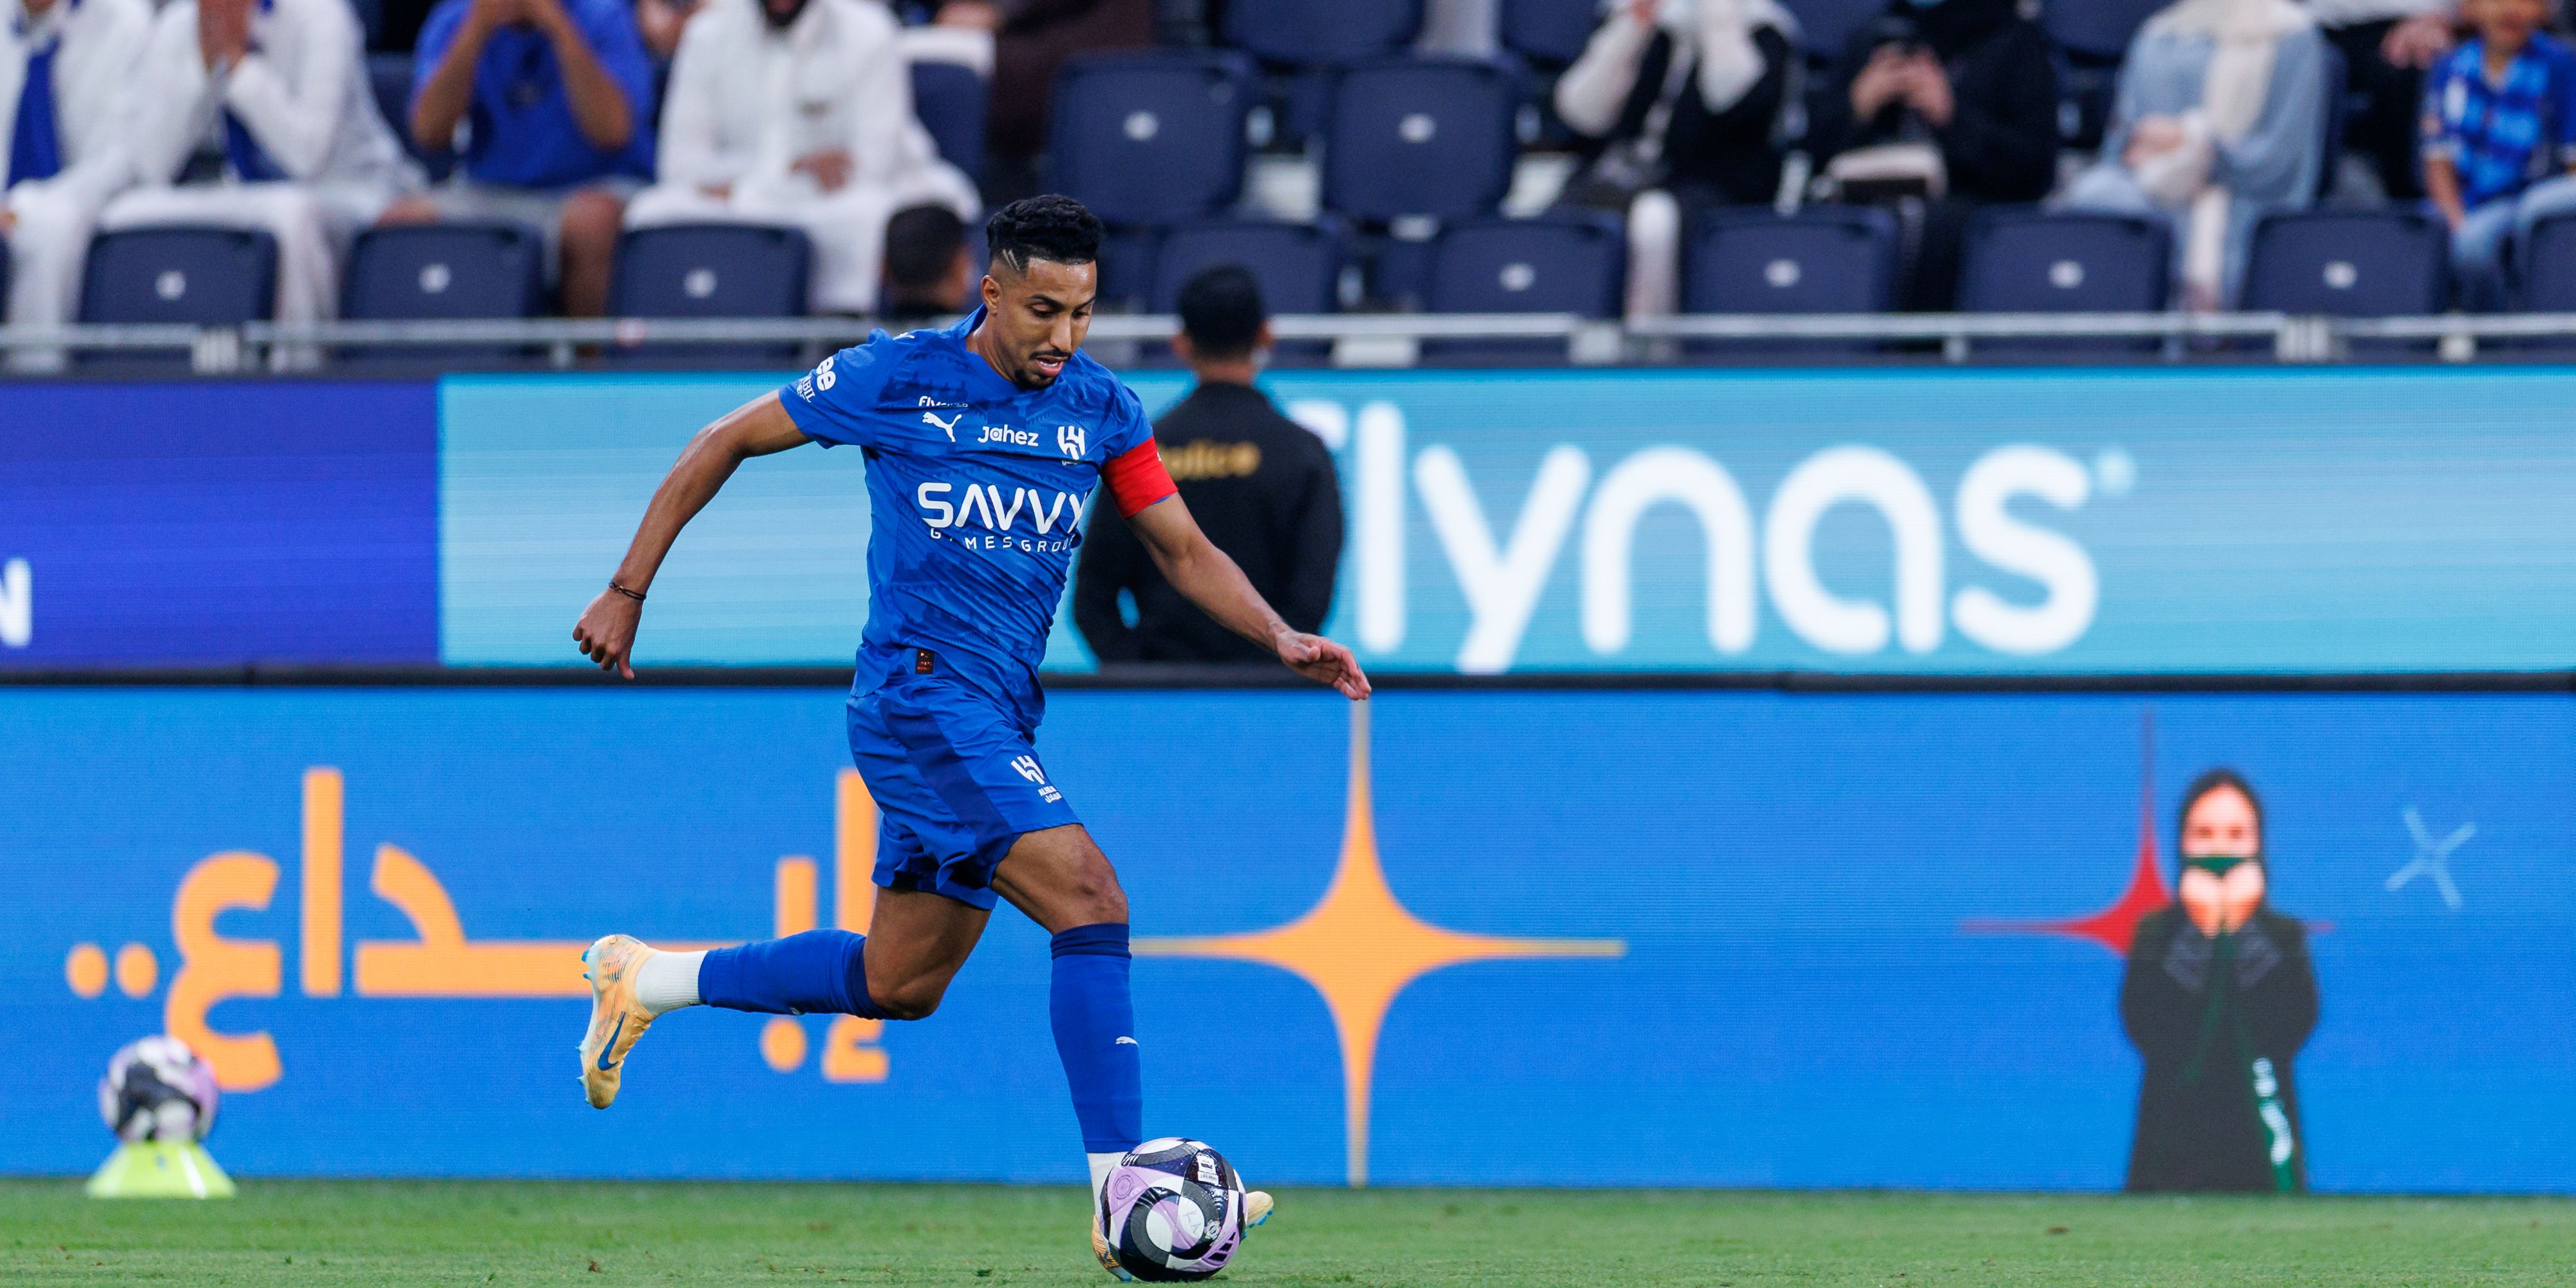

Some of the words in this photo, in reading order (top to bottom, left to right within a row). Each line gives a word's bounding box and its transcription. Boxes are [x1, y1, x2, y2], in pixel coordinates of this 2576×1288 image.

[1157, 438, 1261, 480] olice
[917, 482, 1088, 535] SAVVY
[930, 527, 1013, 550] GMES
[1021, 533, 1076, 553] GROU
